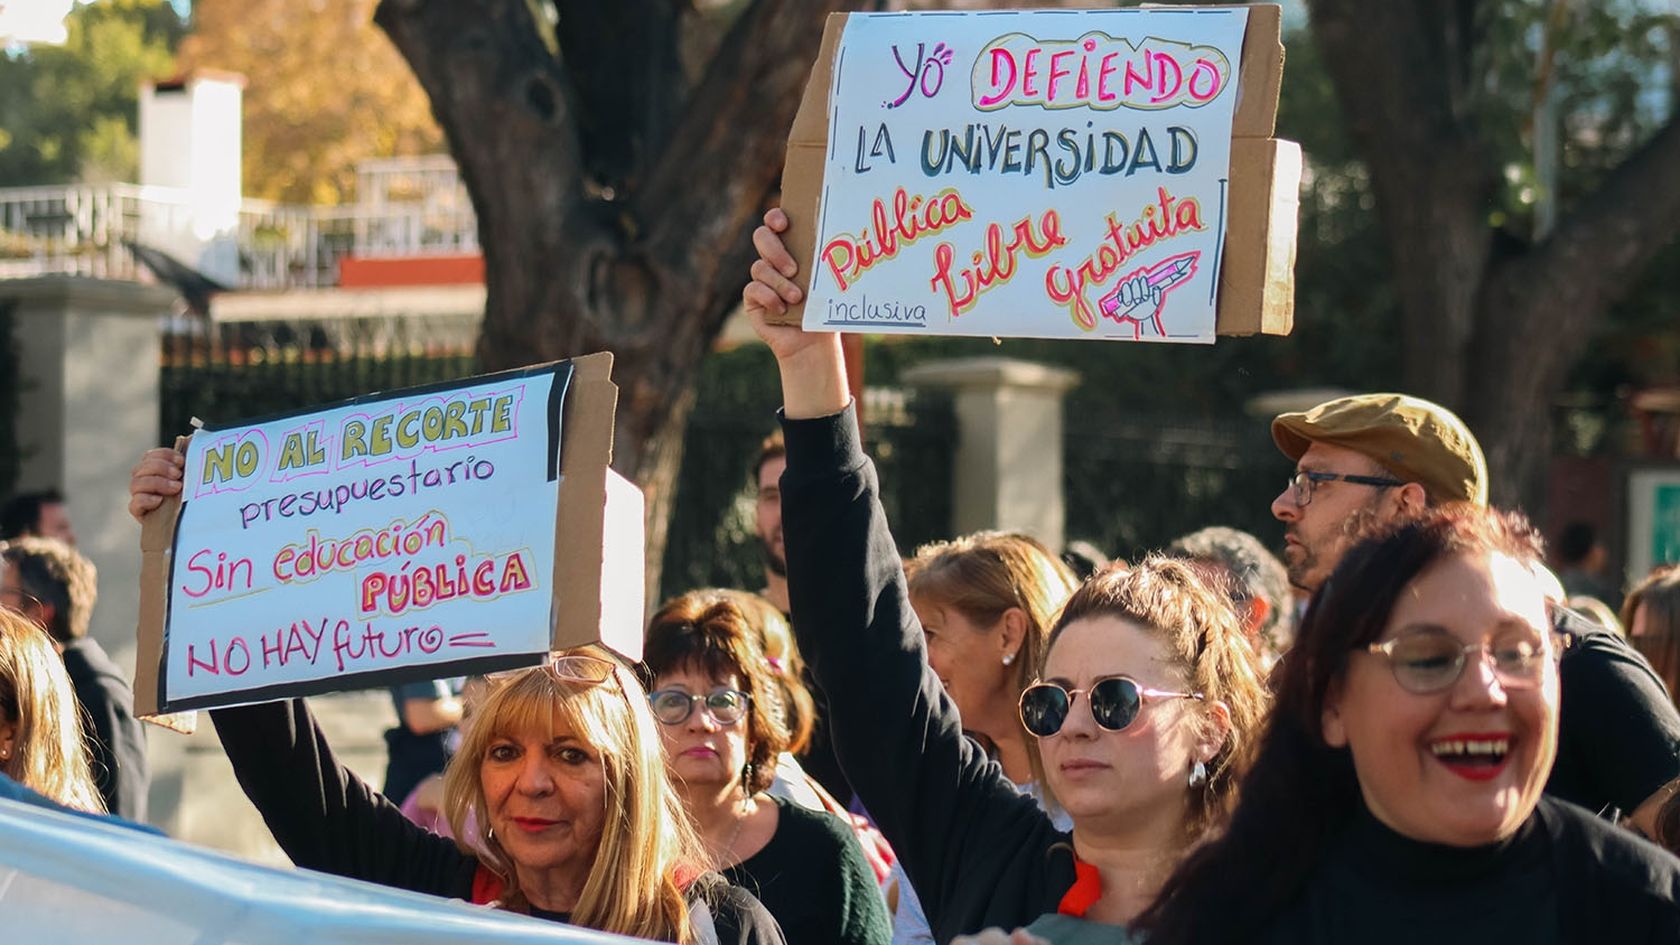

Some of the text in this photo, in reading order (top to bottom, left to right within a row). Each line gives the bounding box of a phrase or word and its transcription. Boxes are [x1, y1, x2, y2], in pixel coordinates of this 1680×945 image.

[856, 122, 896, 173] LA
[822, 186, 1205, 329] Pública Libre gratuita
[827, 298, 927, 322] inclusiva
[203, 395, 514, 485] NO AL RECORTE
[240, 457, 494, 528] presupuestario
[183, 515, 446, 597] Sin educación
[187, 617, 443, 677] NO HAY futuro
